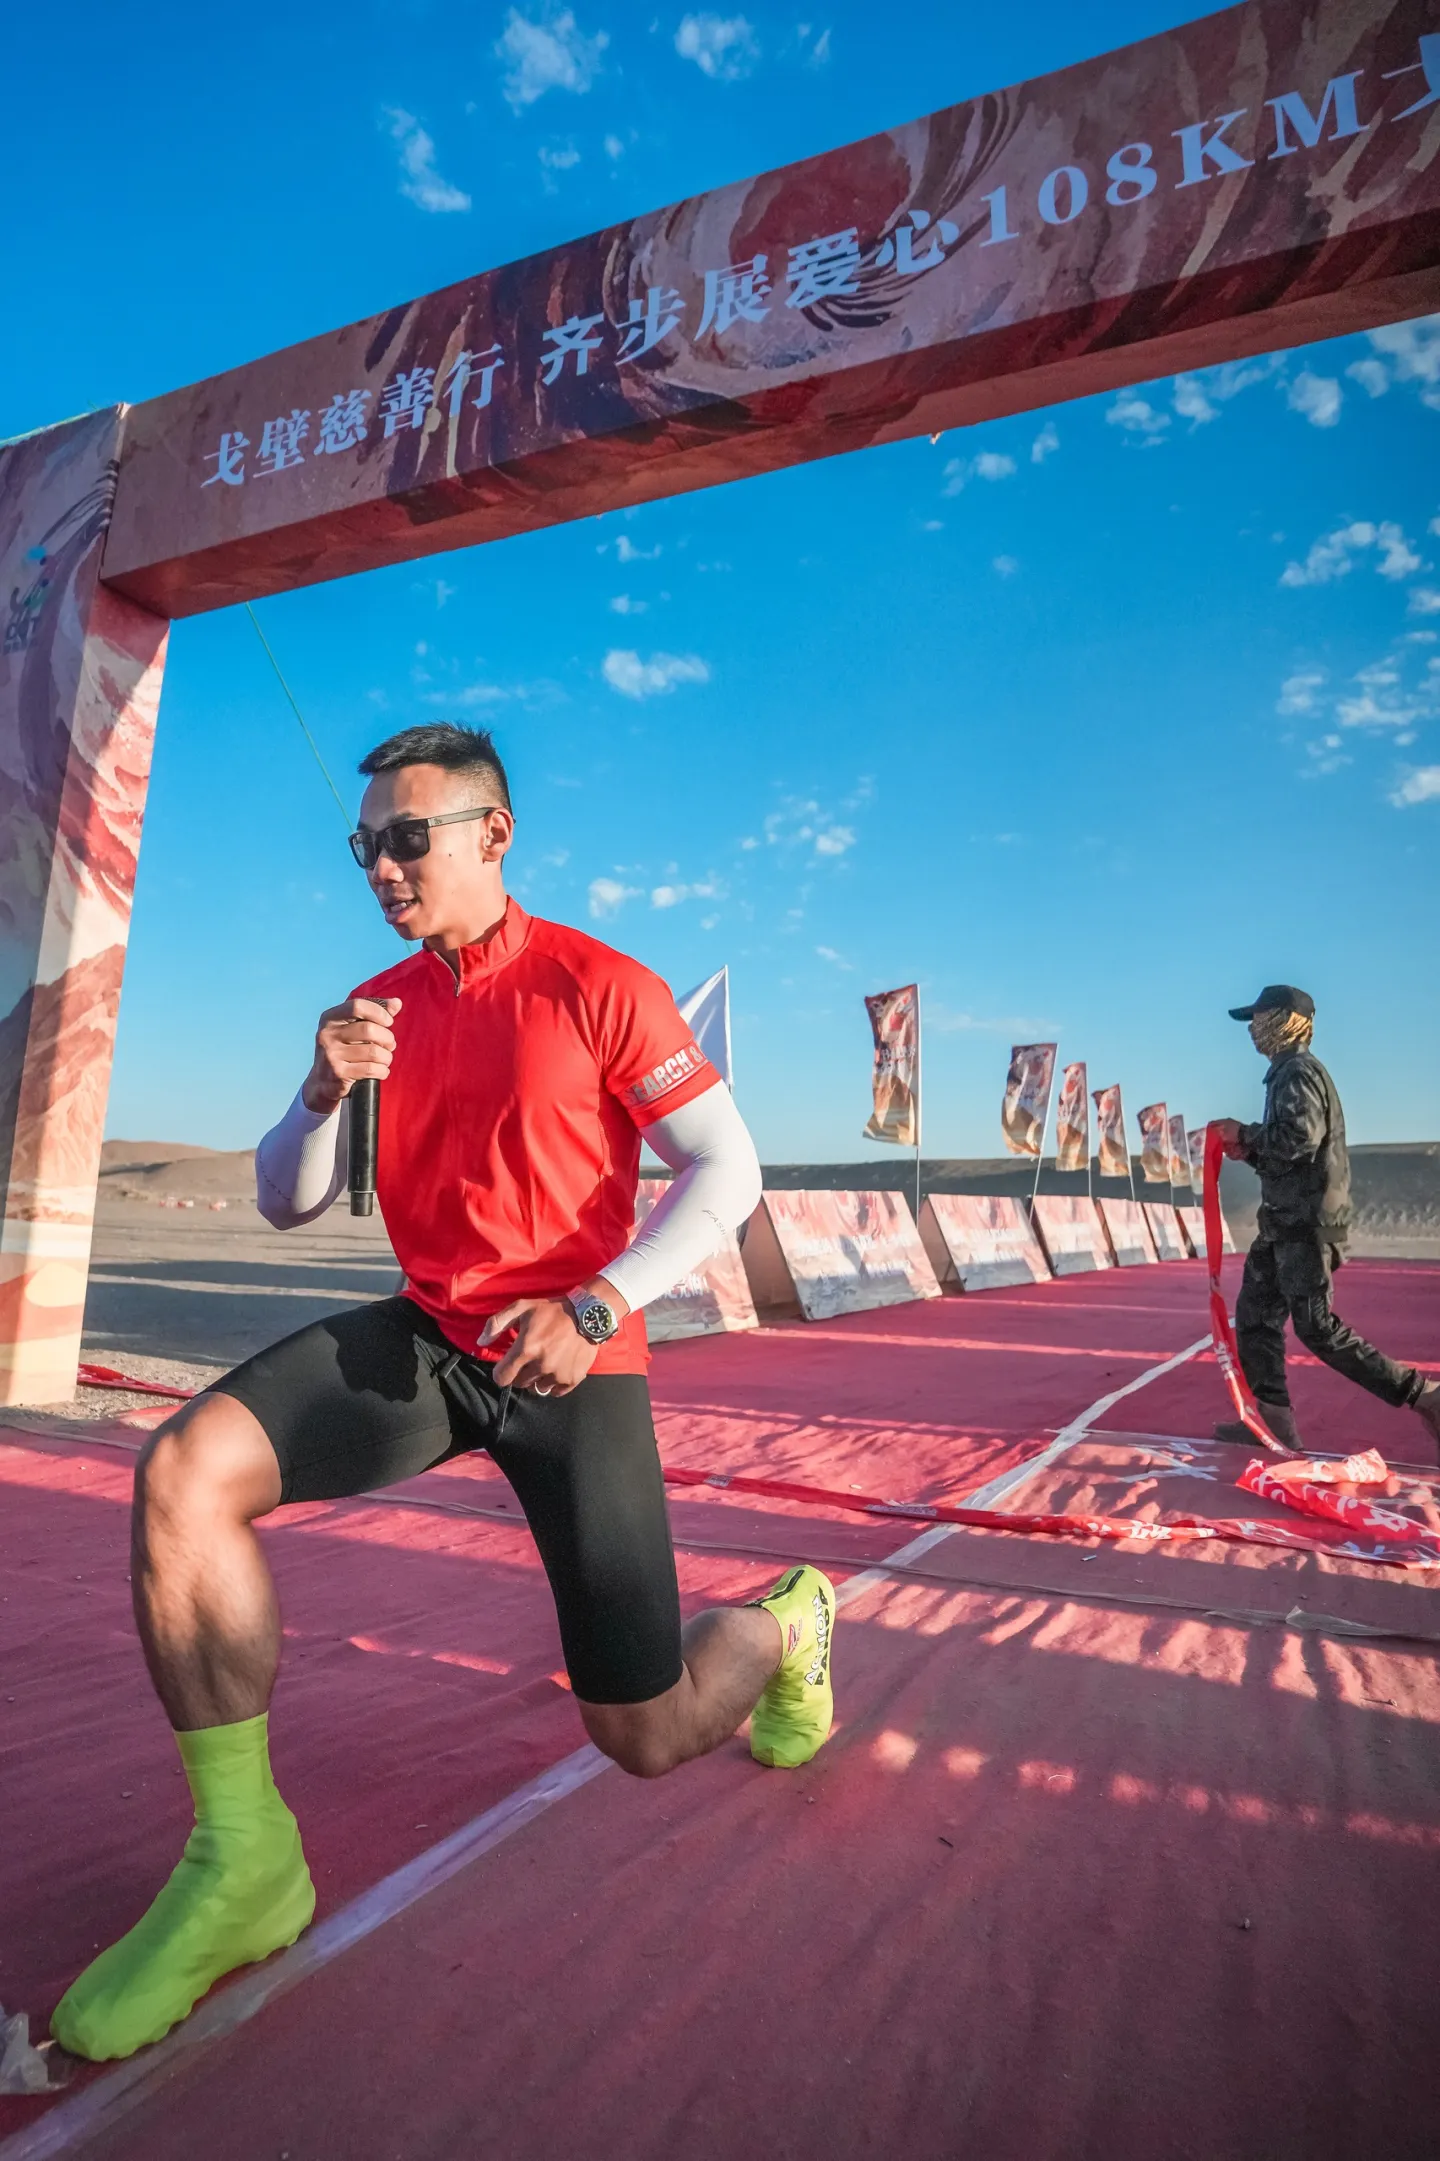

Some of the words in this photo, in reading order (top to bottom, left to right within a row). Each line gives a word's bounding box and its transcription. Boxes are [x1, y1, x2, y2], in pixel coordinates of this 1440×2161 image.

[200, 343, 505, 488] 戈壁慈善行
